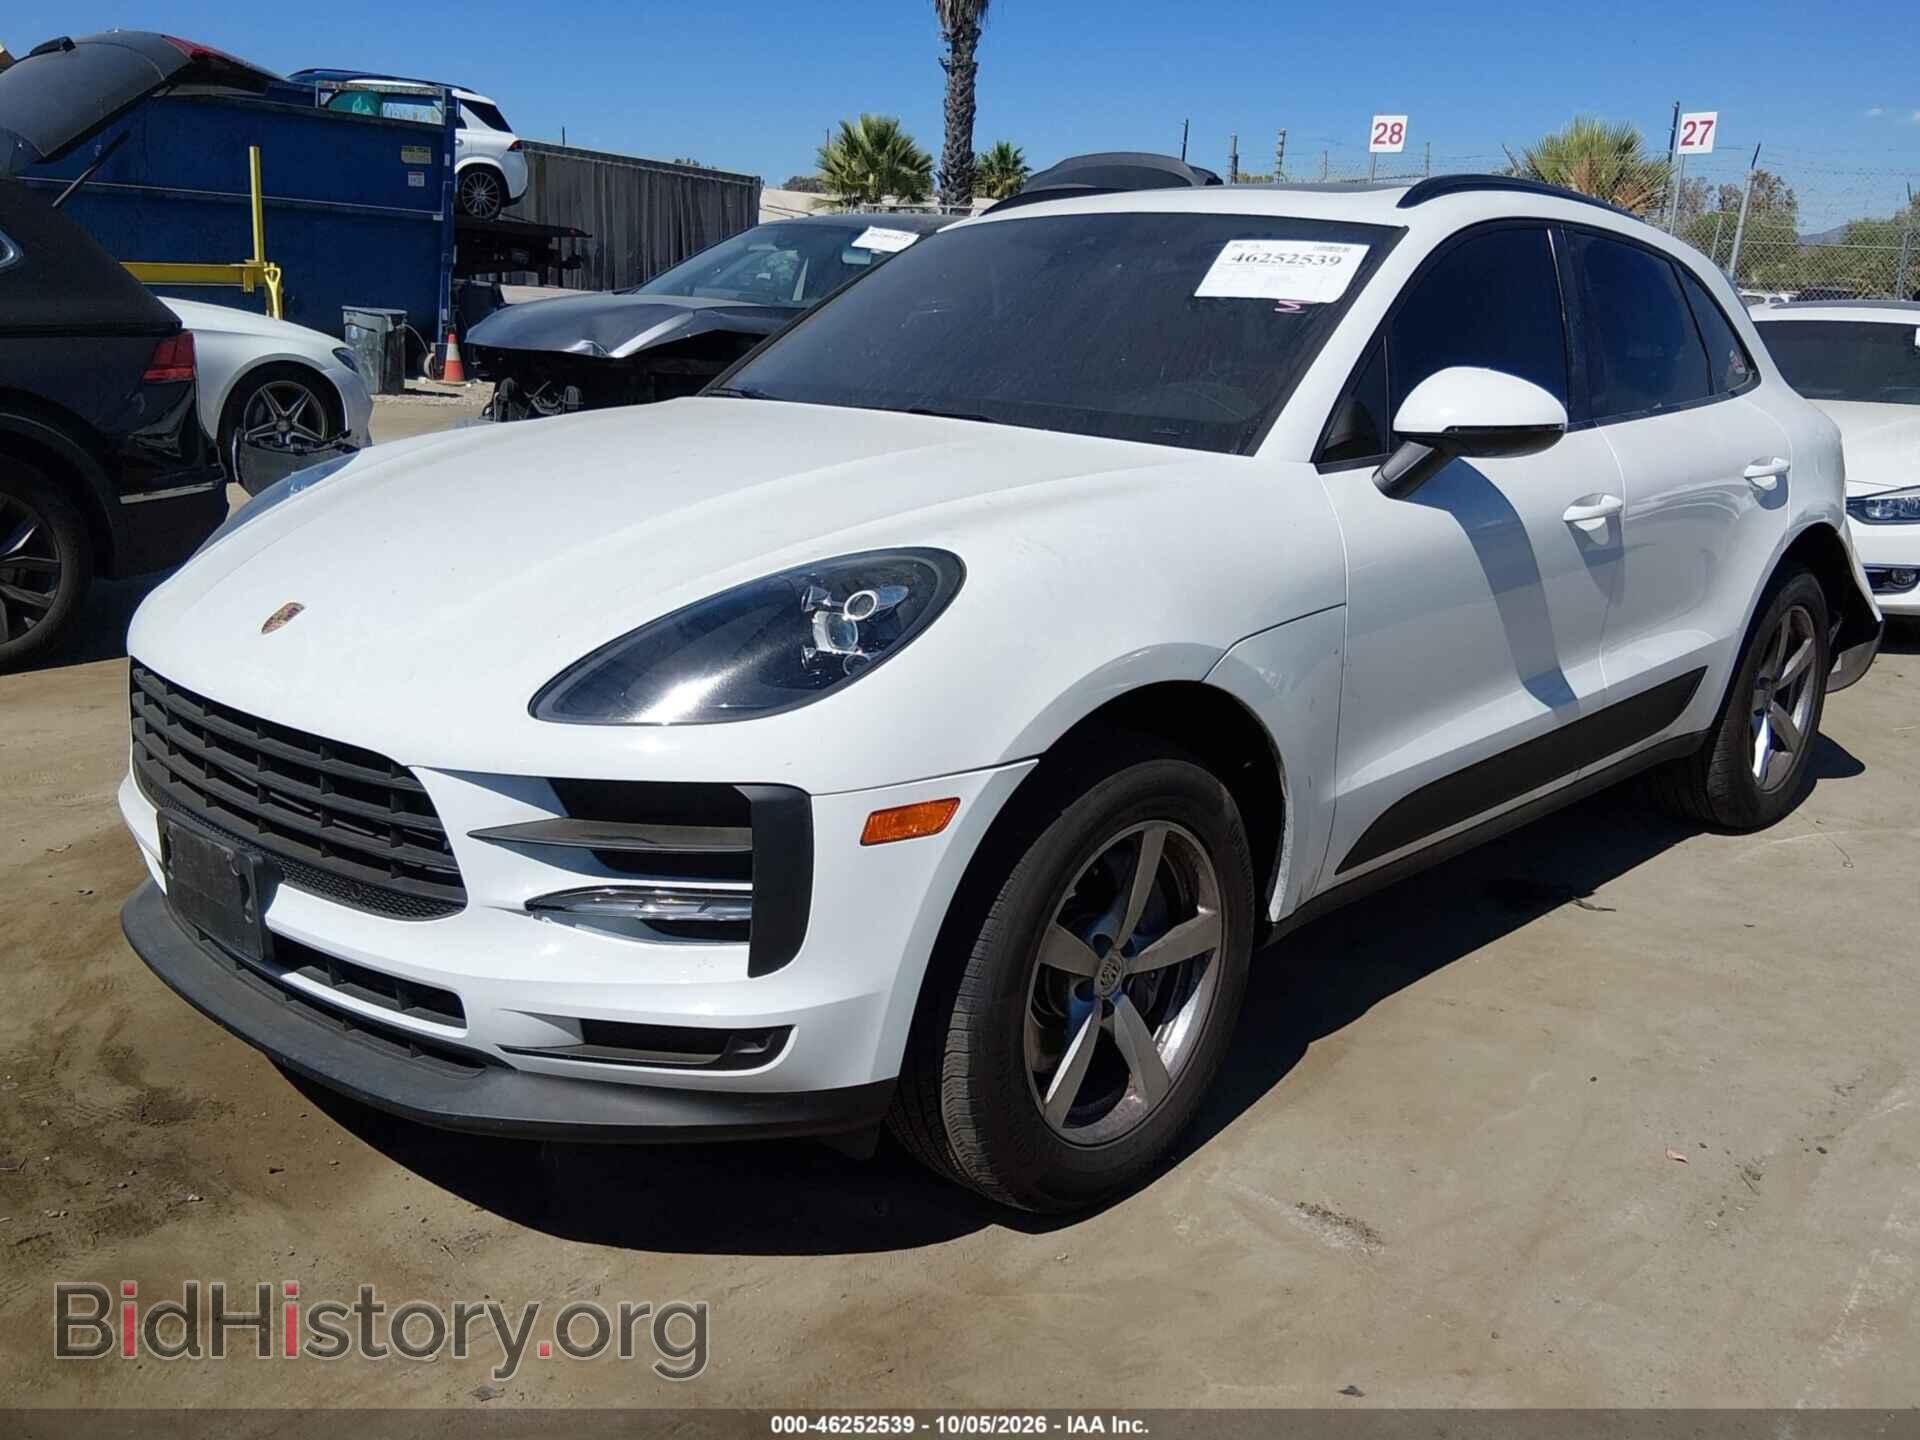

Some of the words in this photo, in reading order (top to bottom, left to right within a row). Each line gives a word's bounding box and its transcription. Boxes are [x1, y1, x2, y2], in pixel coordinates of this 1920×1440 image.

[1373, 122, 1403, 144] 28
[1681, 120, 1714, 145] 27
[1231, 252, 1342, 266] 46252539
